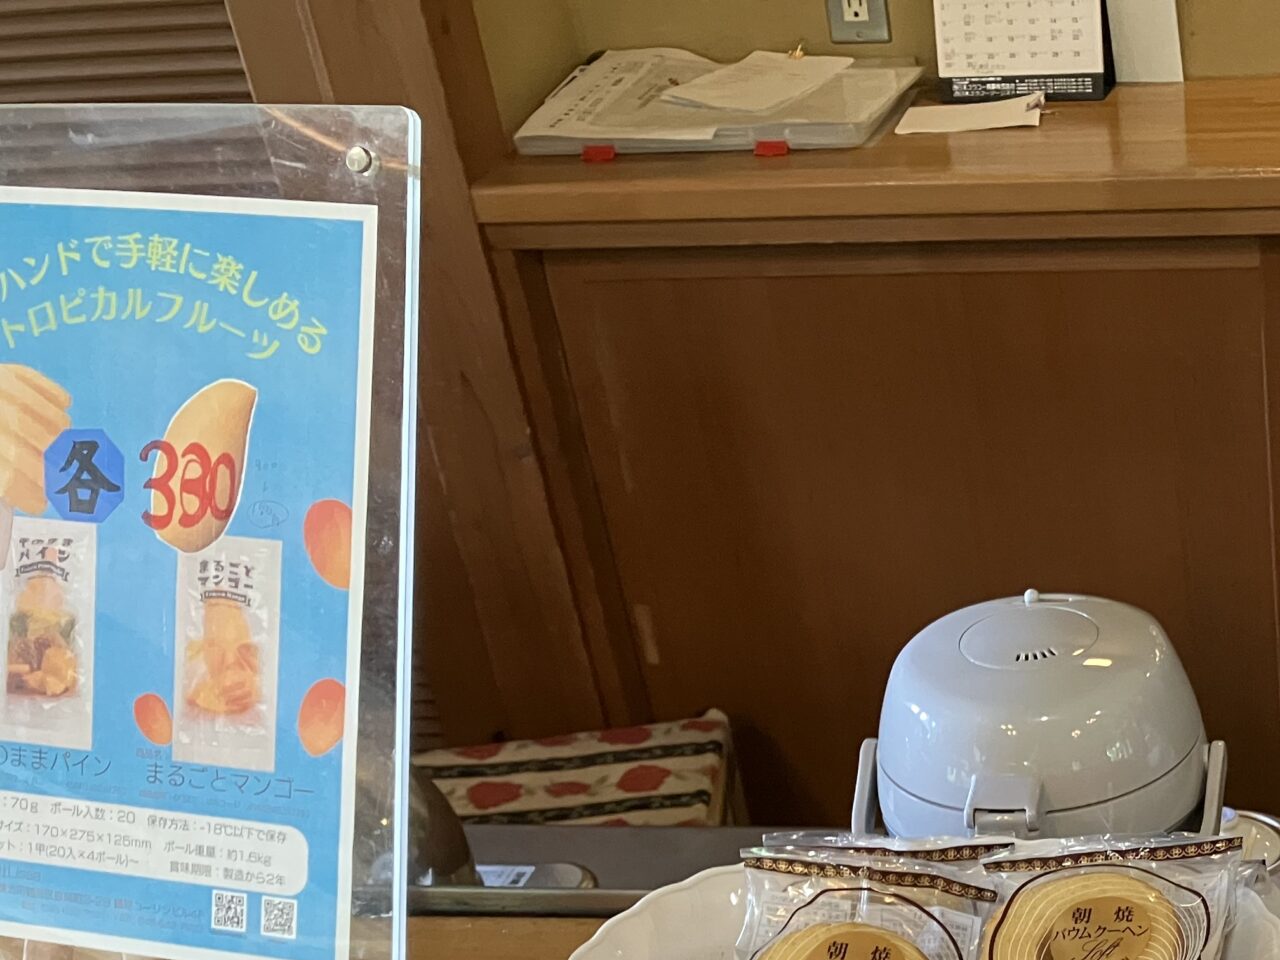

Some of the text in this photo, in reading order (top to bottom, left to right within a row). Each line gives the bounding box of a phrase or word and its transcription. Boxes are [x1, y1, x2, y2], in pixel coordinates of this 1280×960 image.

[0, 286, 280, 360] トロピカルフルーツ
[55, 440, 121, 514] 各
[146, 762, 315, 799] まるごとマンゴー
[1072, 906, 1134, 924] 朝 焼
[1053, 925, 1149, 942] バウムクーヘン
[827, 941, 848, 960] 朝
